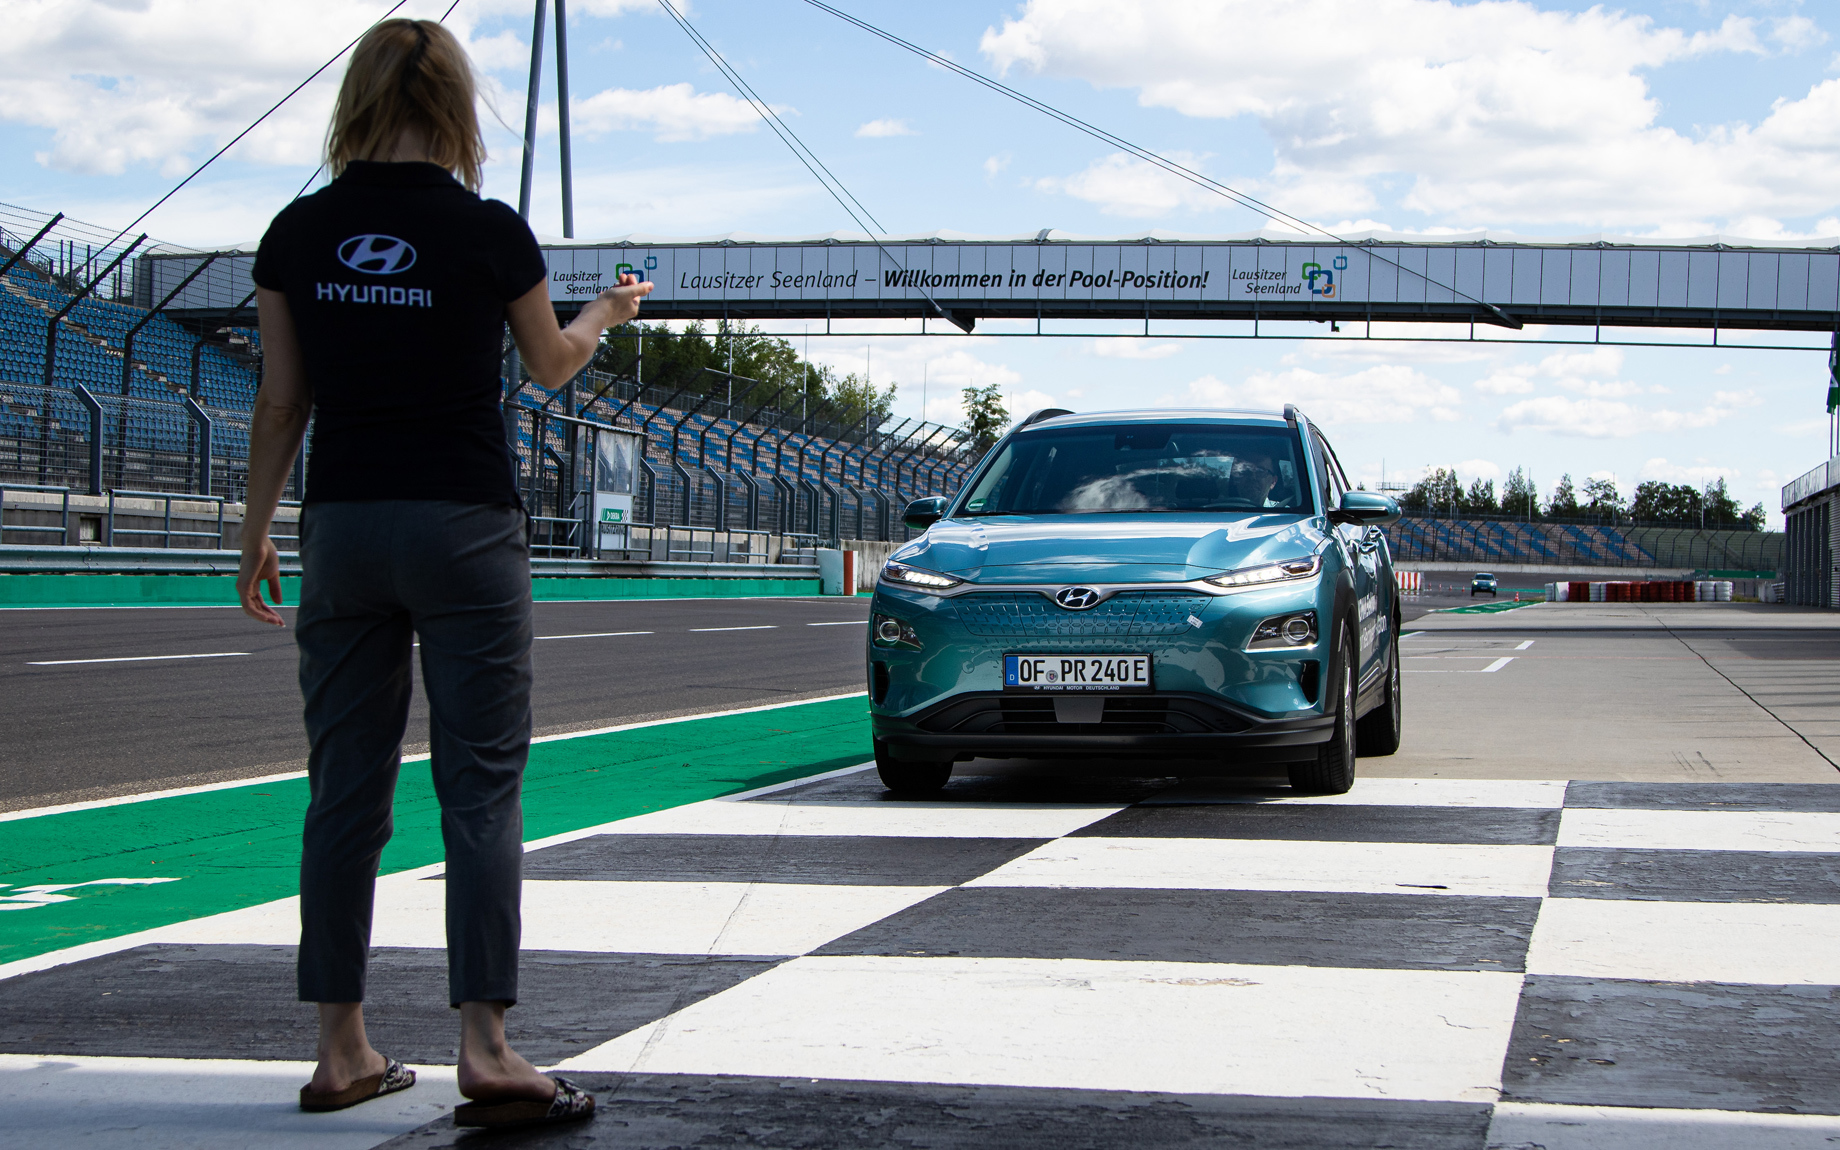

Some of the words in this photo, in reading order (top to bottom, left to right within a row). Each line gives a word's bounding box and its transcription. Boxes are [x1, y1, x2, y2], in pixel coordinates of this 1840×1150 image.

[553, 271, 602, 282] Lausitzer
[680, 271, 764, 289] Lausitzer
[770, 270, 858, 288] Seenland
[884, 269, 1003, 288] Willkommen
[1008, 269, 1026, 288] in
[1032, 269, 1066, 287] der
[1069, 269, 1210, 289] Pool-Position!
[1232, 269, 1287, 281] Lausitzer
[316, 282, 432, 307] HYUNDAI
[1245, 283, 1302, 294] Seenland
[1020, 659, 1045, 682] OF
[1060, 659, 1087, 682] PR
